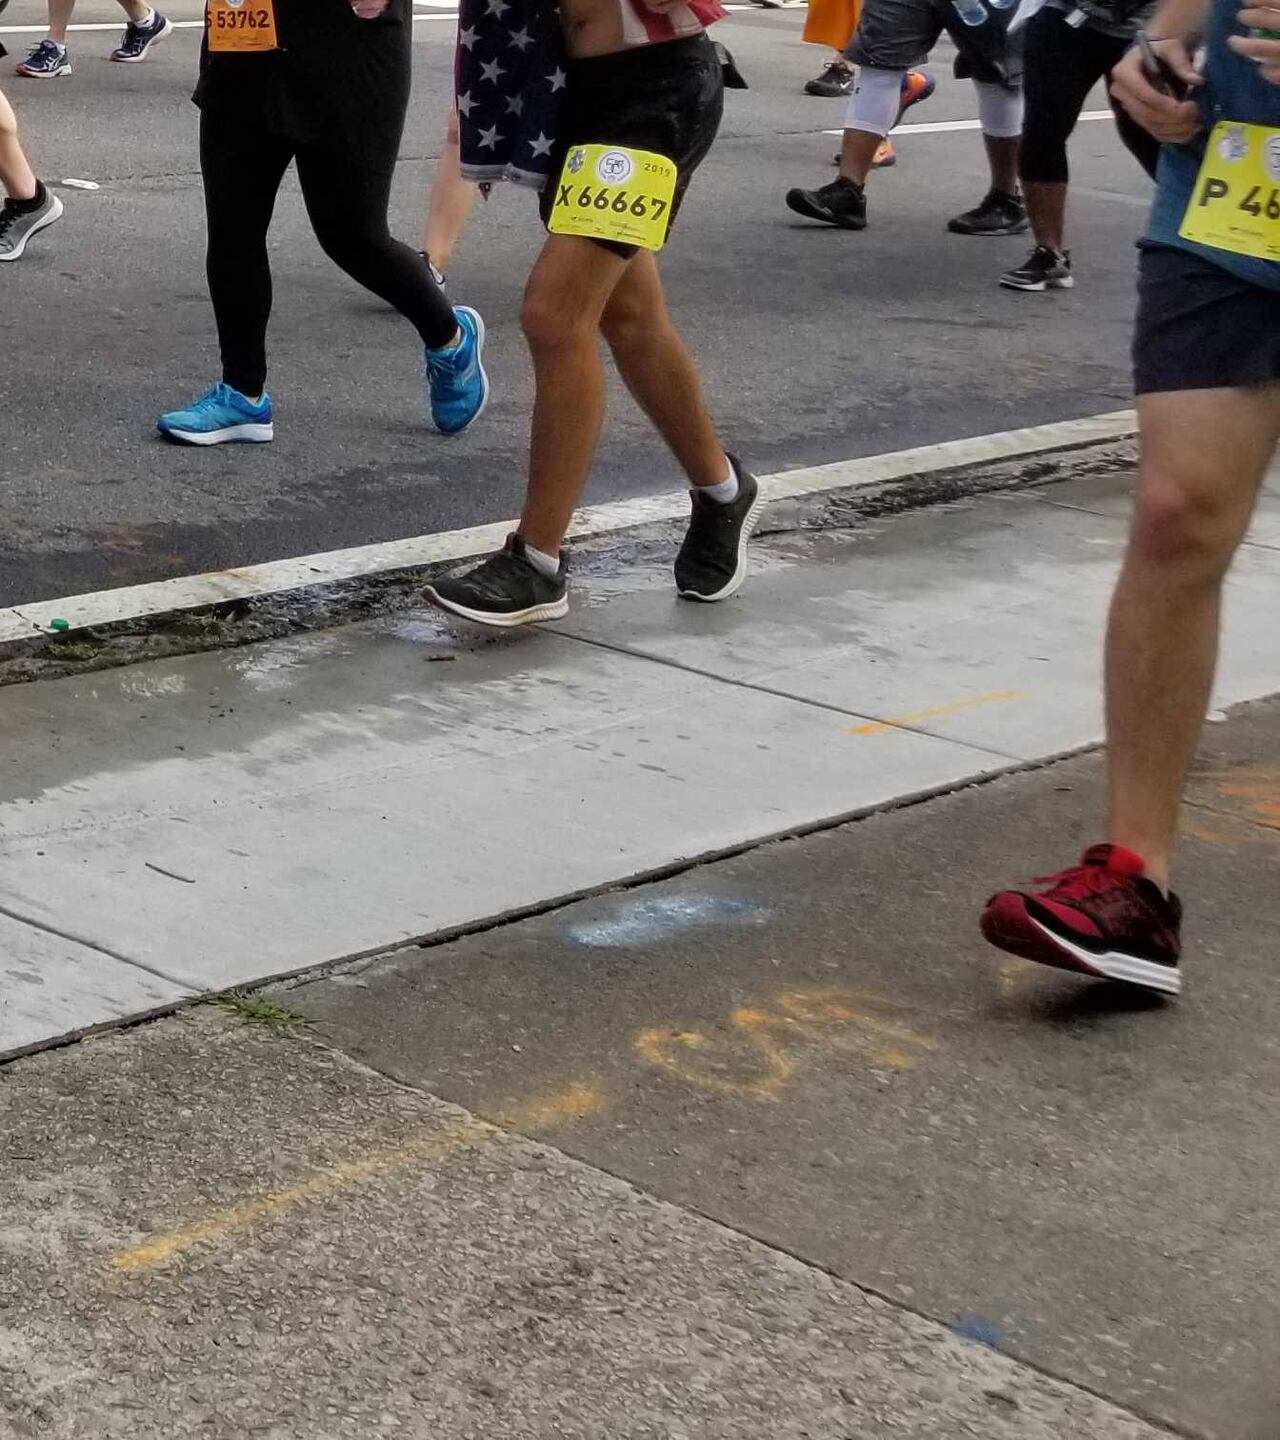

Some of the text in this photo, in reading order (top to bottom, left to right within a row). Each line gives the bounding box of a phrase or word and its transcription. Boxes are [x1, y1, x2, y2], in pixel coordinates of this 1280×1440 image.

[217, 9, 271, 29] 53762
[643, 162, 671, 177] 2019
[555, 184, 668, 221] X 66667
[1198, 177, 1280, 220] P 46
